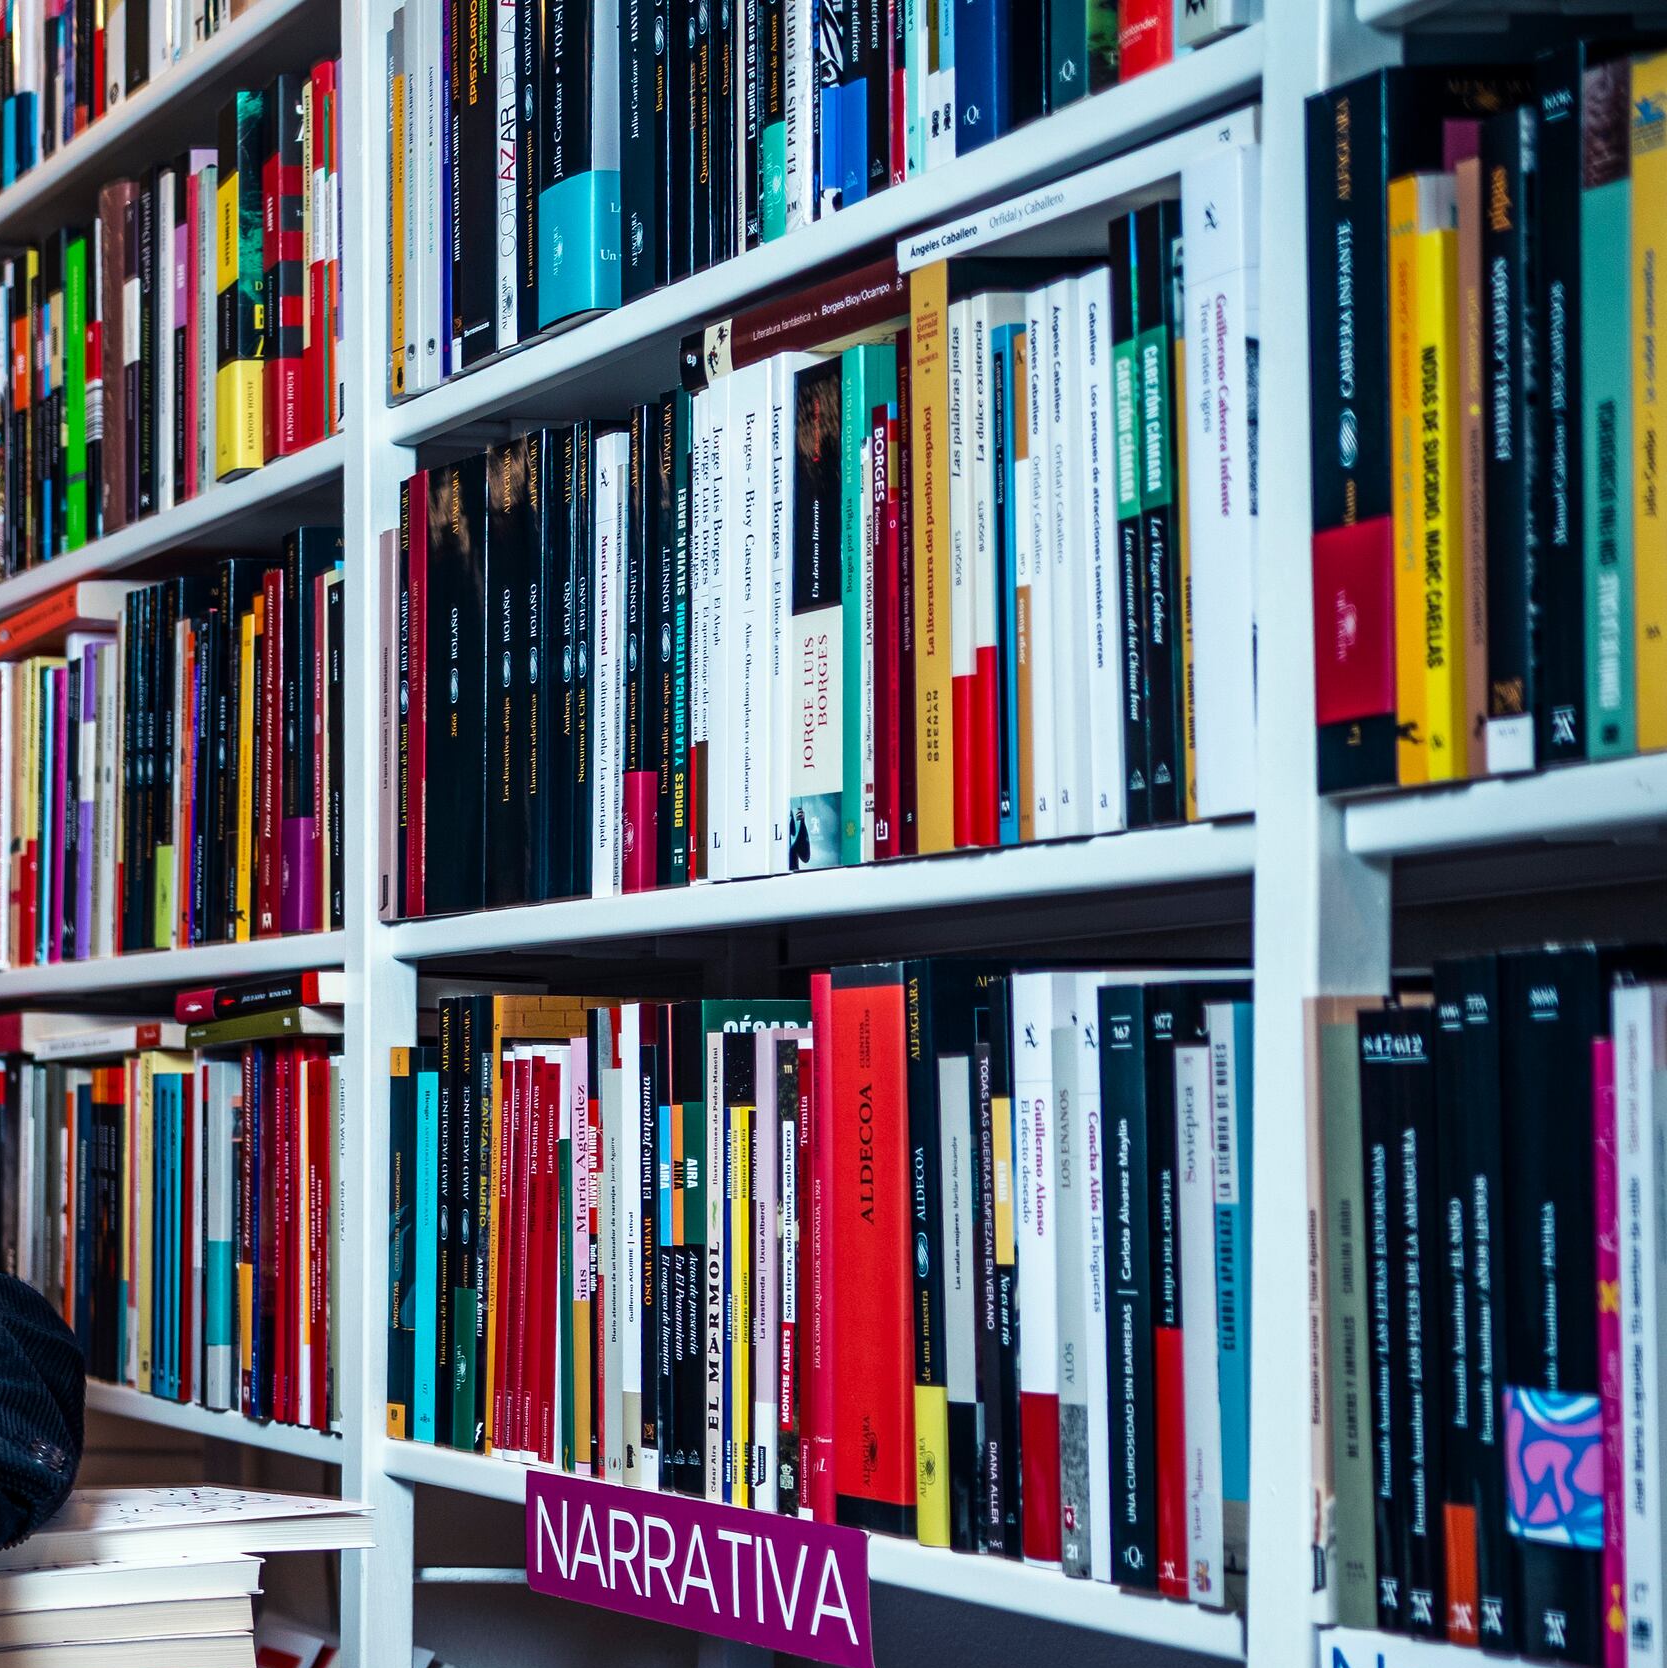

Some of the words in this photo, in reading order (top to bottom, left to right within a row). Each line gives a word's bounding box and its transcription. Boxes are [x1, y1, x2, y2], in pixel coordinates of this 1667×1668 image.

[699, 44, 707, 86] Glenda
[654, 65, 663, 113] Bestiario
[700, 91, 707, 100] a
[553, 82, 564, 147] Cortázar
[699, 102, 707, 135] tanto
[553, 150, 564, 179] Julio
[699, 136, 707, 184] Queremos
[910, 238, 940, 258] Ángeles
[941, 224, 978, 249] Caballero
[753, 324, 780, 341] Literatura
[782, 312, 811, 331] fantástica
[287, 370, 296, 401] HOUSE
[286, 402, 295, 442] RANDOM
[744, 412, 757, 472] Borges
[872, 426, 886, 502] BORGES
[678, 487, 687, 533] BAREI
[744, 490, 758, 523] Bioy
[677, 551, 686, 597] SILVIA
[746, 528, 756, 601] Casares
[629, 557, 638, 624] BONNETT
[451, 607, 459, 660] BOLAÑO
[676, 601, 686, 676] LITERARIA
[802, 636, 815, 689] LUIS
[817, 634, 829, 727] BORGES
[675, 682, 685, 735] CRÍTICA
[675, 738, 684, 755] LA
[802, 701, 816, 770] JORGE
[675, 756, 684, 765] Y
[675, 772, 685, 828] BORGES
[799, 1095, 809, 1147] Termita
[861, 1082, 876, 1225] ALDECOA
[643, 1217, 653, 1263] AIBAR
[643, 1267, 653, 1306] ÓSCAR
[707, 1239, 721, 1393] MÁRMOL
[781, 1328, 791, 1375] ALBETS
[708, 1405, 721, 1432] EL
[781, 1379, 791, 1423] MONTSE
[536, 1495, 859, 1646] NARRATIVA
